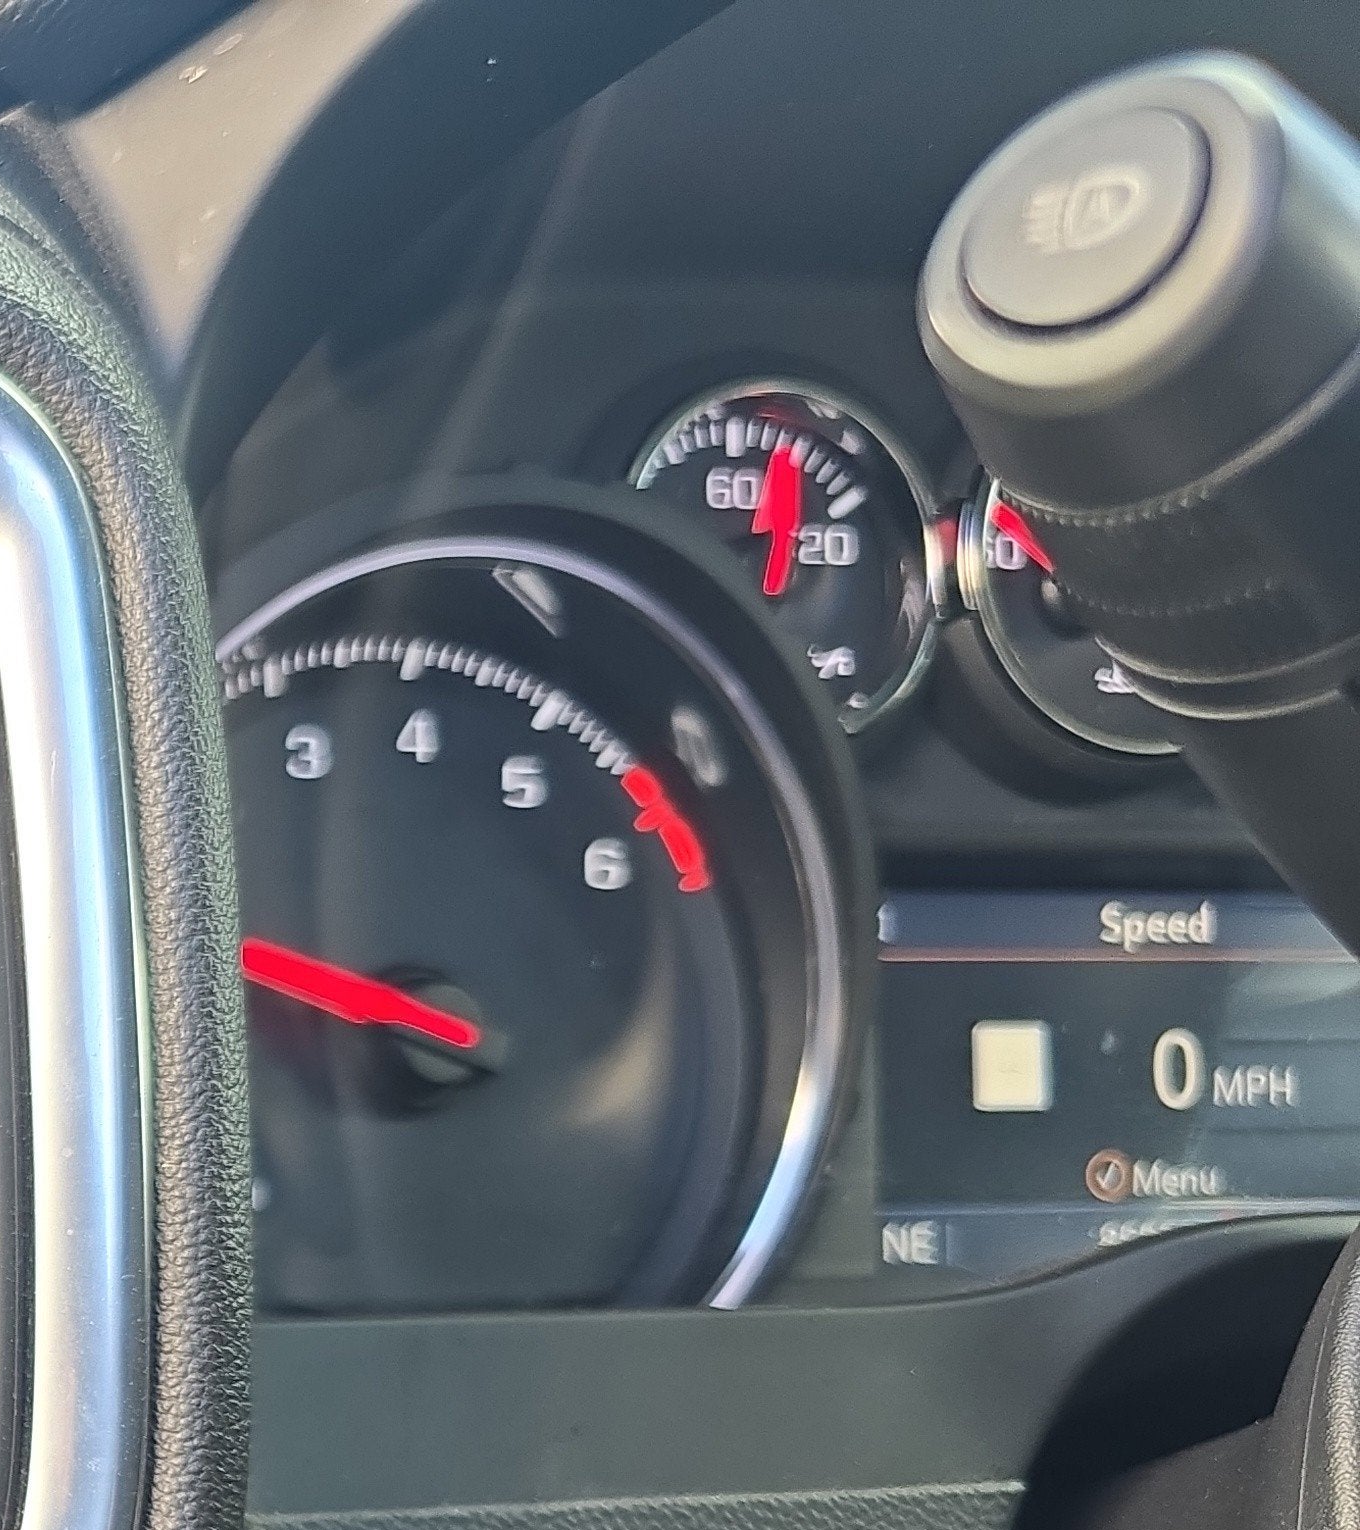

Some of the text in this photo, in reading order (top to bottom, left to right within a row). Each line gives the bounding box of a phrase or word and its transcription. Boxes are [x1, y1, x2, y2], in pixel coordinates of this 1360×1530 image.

[706, 468, 767, 509] 60
[788, 523, 860, 566] 20
[285, 724, 332, 779] 3
[396, 709, 438, 763] 4
[501, 754, 548, 808] 5
[584, 837, 632, 890] 6
[1099, 900, 1217, 952] Speed
[1153, 1027, 1298, 1110] 0 MPH
[1132, 1161, 1221, 1196] Menu
[883, 1221, 940, 1265] NE
